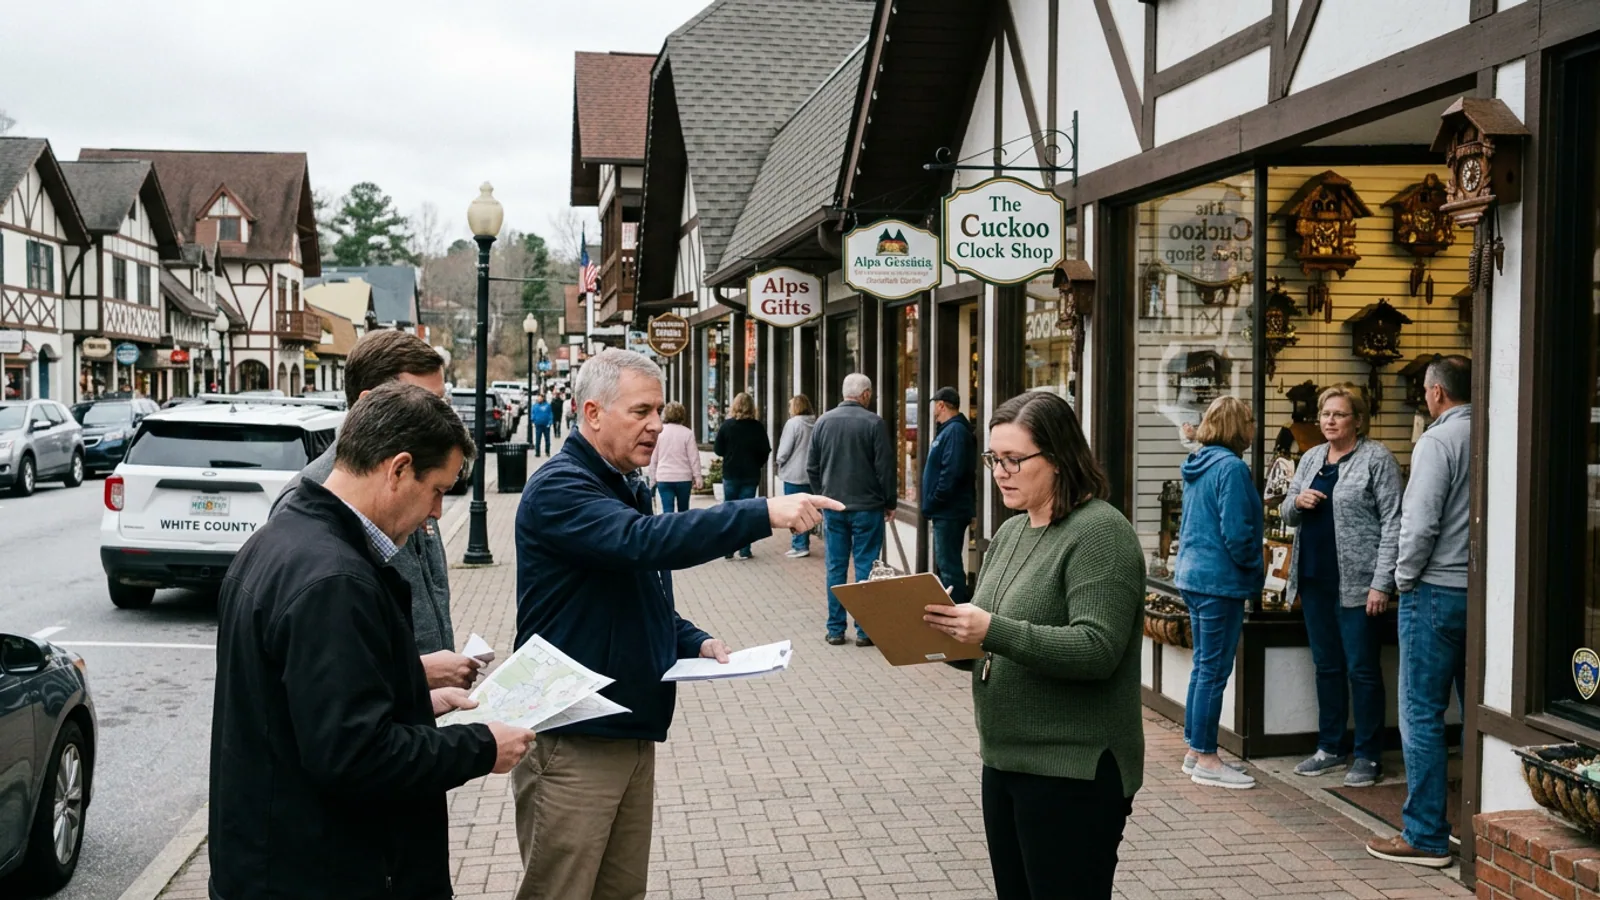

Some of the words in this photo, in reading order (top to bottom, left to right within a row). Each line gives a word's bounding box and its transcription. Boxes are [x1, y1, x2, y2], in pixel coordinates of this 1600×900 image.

[989, 196, 1022, 212] The
[960, 213, 1050, 238] Cuckoo
[957, 242, 1005, 258] Clock
[1011, 242, 1054, 263] Shop
[762, 277, 810, 297] Alps
[761, 299, 812, 315] Gifts
[160, 519, 201, 531] WHITE
[203, 521, 257, 532] COUNTY
